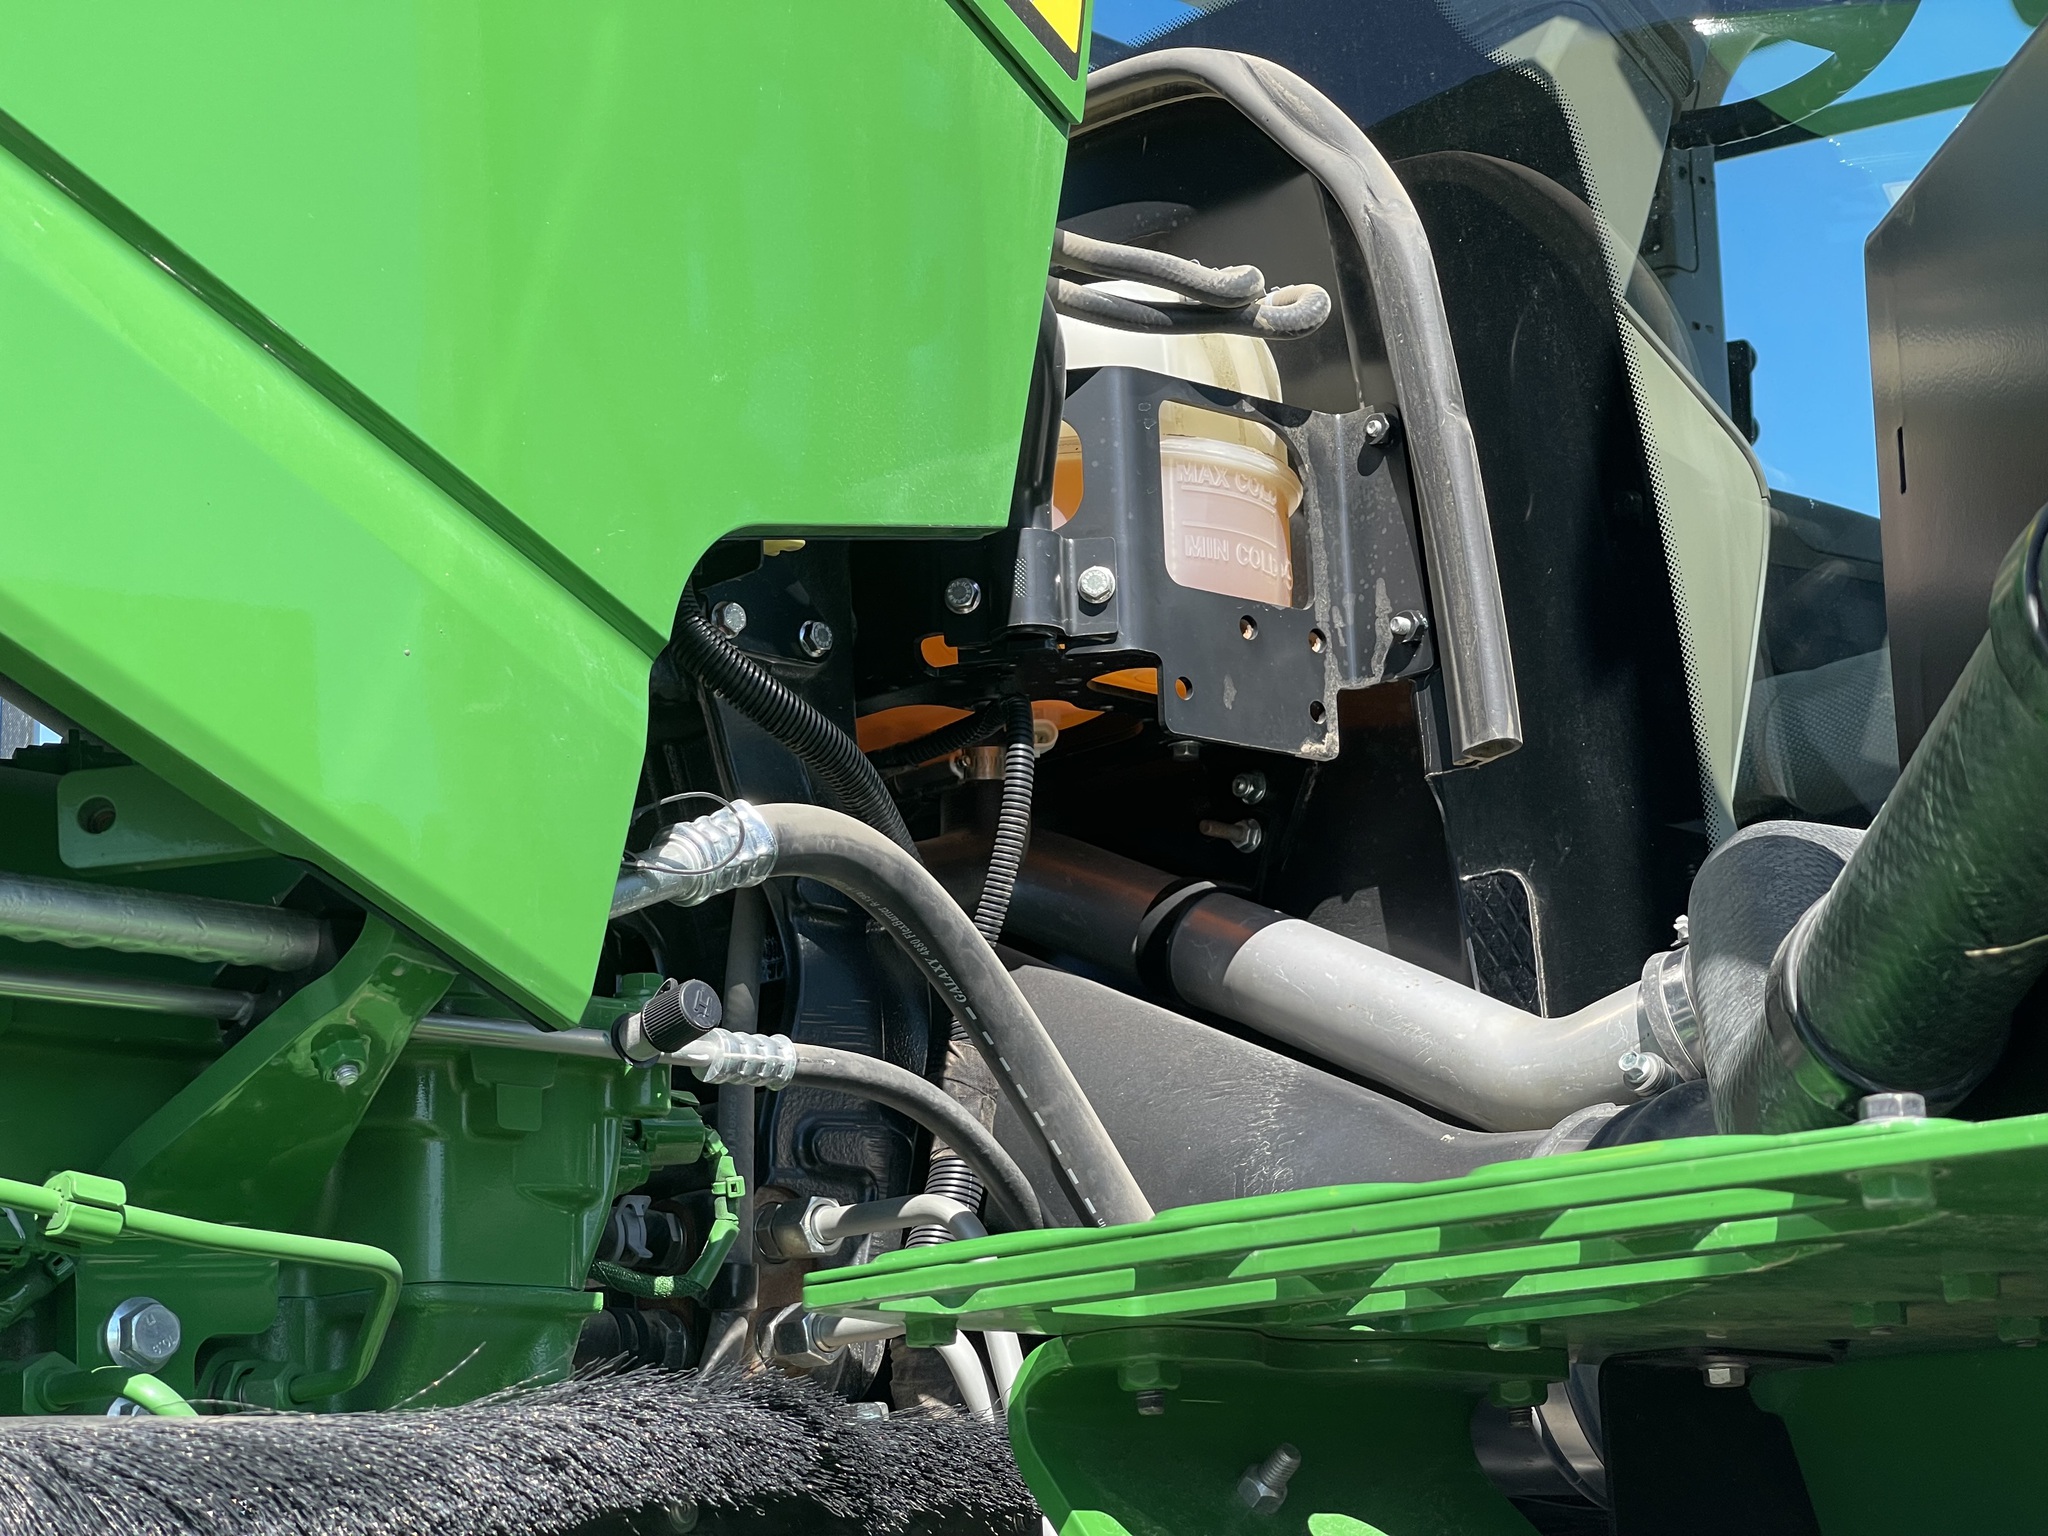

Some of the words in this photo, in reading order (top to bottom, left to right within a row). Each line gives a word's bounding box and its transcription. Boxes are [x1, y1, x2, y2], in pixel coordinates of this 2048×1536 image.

[1176, 464, 1231, 488] MAX
[1184, 535, 1230, 561] MIN
[878, 906, 916, 940] FlexBarrier
[910, 938, 931, 957] 4880
[924, 958, 967, 1003] GALAXY
